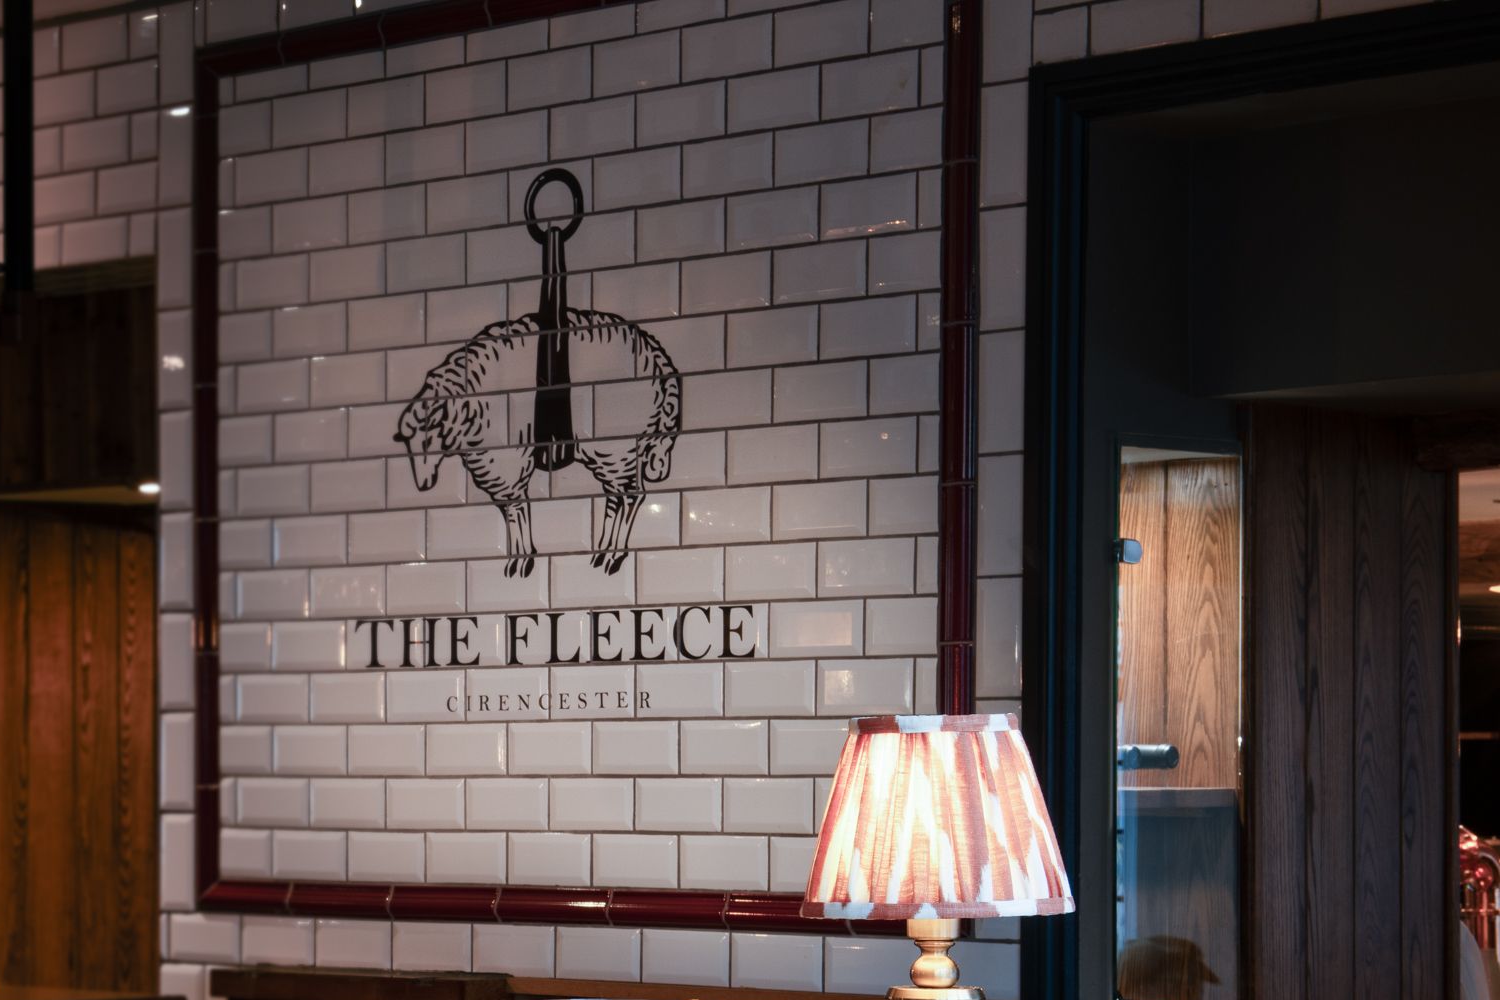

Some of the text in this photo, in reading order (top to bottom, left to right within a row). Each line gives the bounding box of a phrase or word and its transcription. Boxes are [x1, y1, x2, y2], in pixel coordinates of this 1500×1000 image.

[354, 605, 756, 668] THE FLEECE
[446, 691, 652, 713] CIRENCESTER
